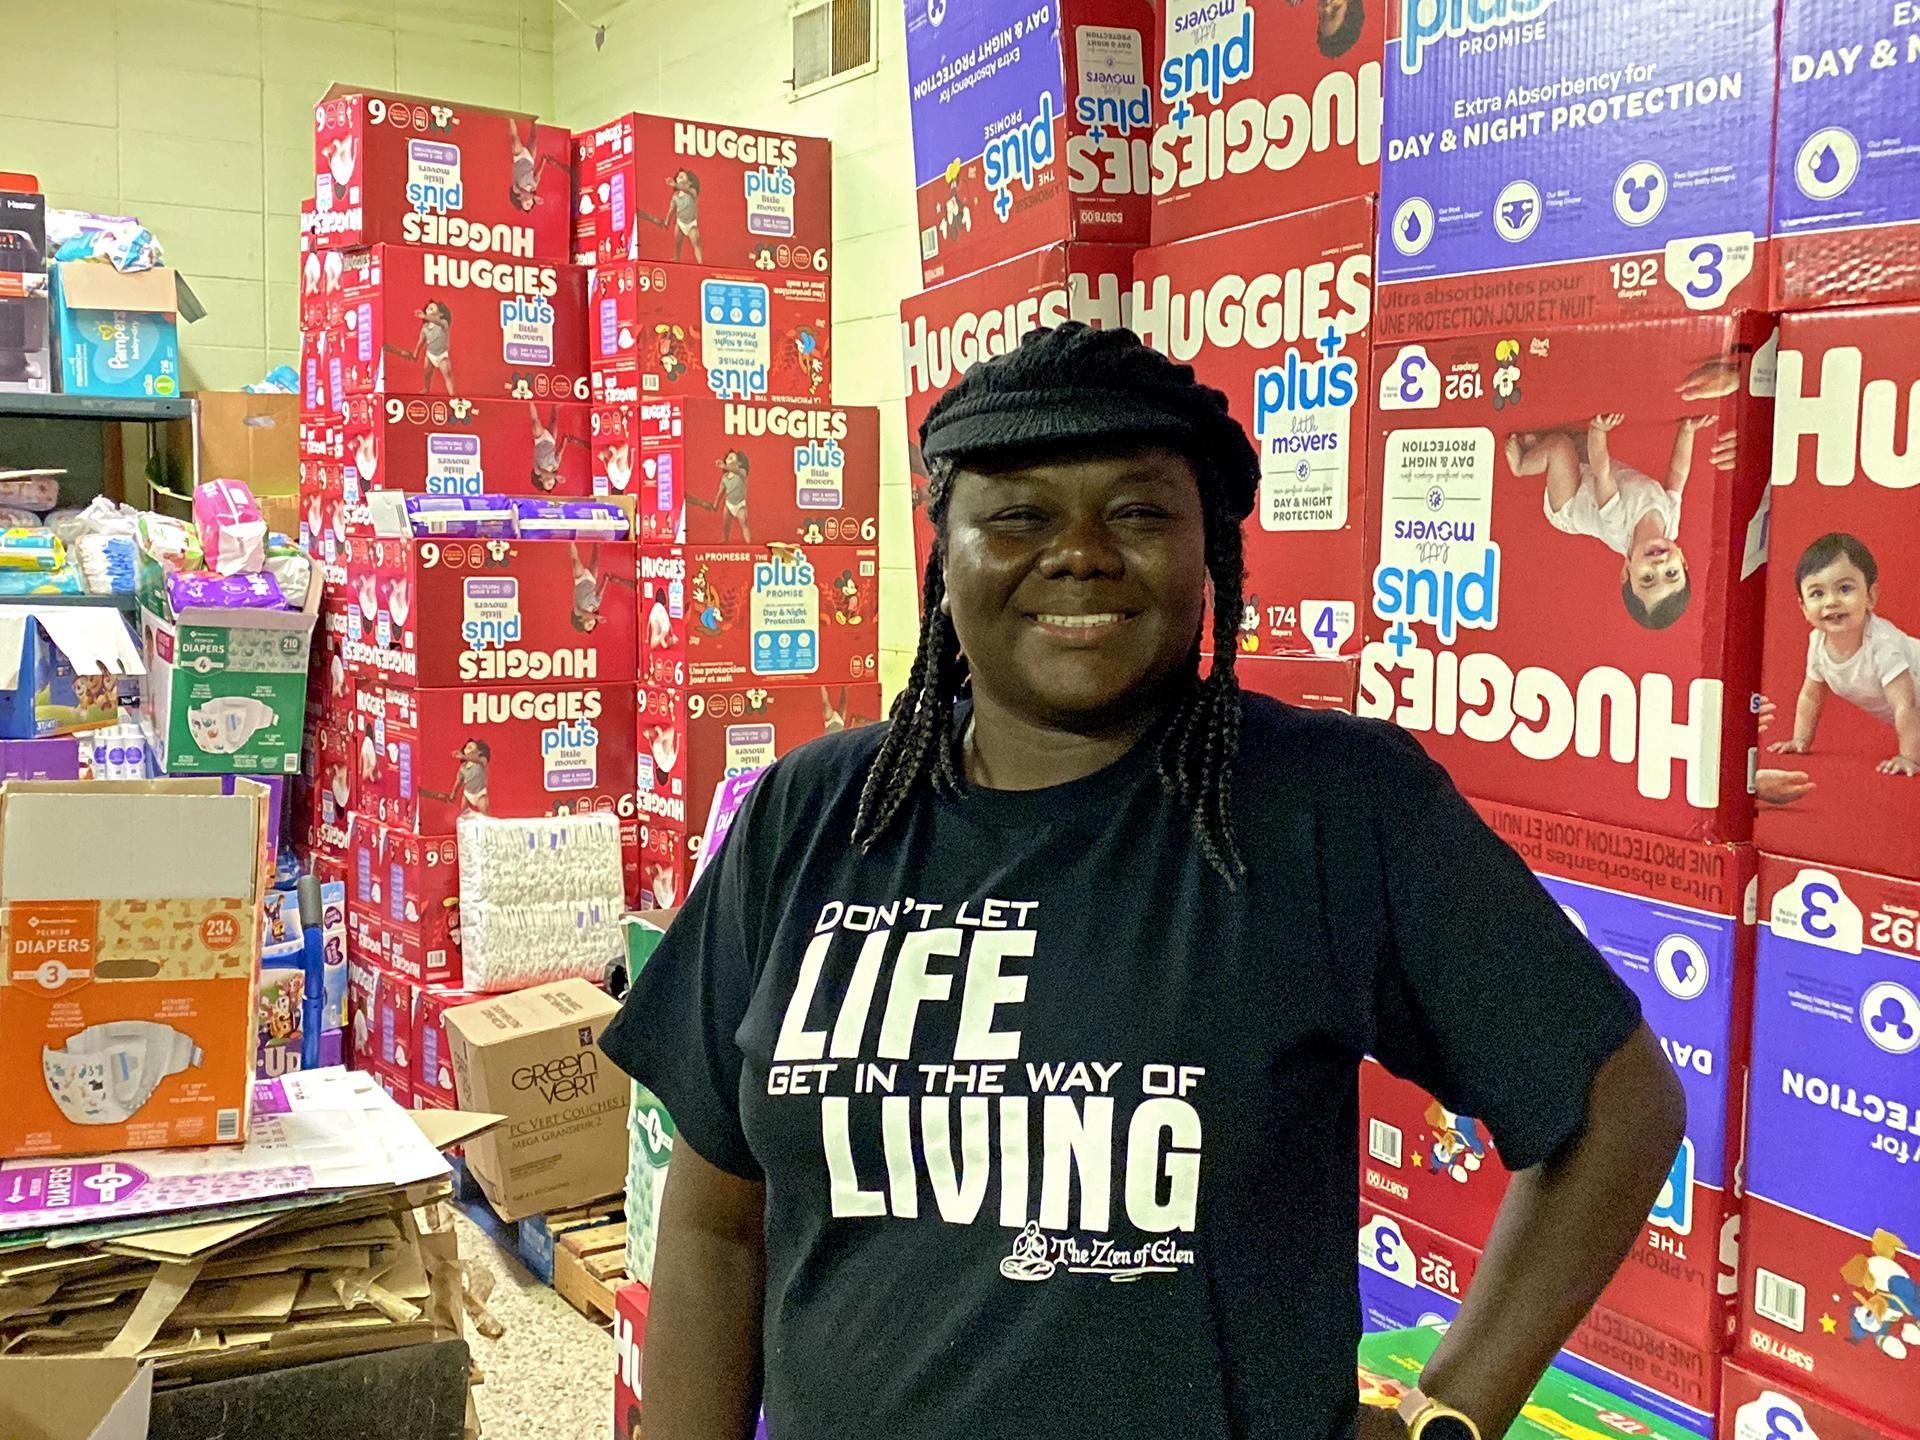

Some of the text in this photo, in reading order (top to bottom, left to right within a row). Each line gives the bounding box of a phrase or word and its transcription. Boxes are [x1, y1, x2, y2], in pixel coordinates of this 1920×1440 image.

[1174, 0, 1235, 33] movers
[1086, 31, 1132, 41] PROTECTION
[1087, 40, 1132, 50] DAY NIGHT
[1459, 21, 1546, 59] PROMISE
[914, 5, 1050, 101] DAY & NIGHT PROTECTION
[1163, 12, 1251, 100] plus
[1792, 45, 1862, 84] DAY
[1870, 39, 1898, 69] &
[938, 46, 1021, 104] Extra Absorbency for
[1086, 71, 1135, 85] movers
[1454, 62, 1657, 119] Extra Absorbency for
[367, 99, 386, 125] 6
[1079, 87, 1150, 133] plus
[1388, 72, 1743, 163] DAY & NIGHT PROTECTION
[984, 108, 1023, 140] PROMISE
[674, 123, 798, 169] HUGGIES
[985, 97, 1052, 187] plus
[417, 165, 451, 176] movers
[423, 174, 445, 185] little
[746, 169, 793, 197] plus
[1038, 169, 1055, 187] THE
[409, 182, 462, 213] plus
[756, 203, 786, 213] movers
[761, 195, 780, 205] little
[402, 212, 535, 258] HUGGIES
[812, 248, 828, 272] 6
[1686, 243, 1723, 298] 3
[424, 254, 558, 297] HUGGIES
[1610, 259, 1658, 289] 192
[1424, 275, 1585, 305] absorbantes pour
[1618, 289, 1648, 299] diapers
[503, 298, 552, 326] plus
[1133, 254, 1371, 362] HUGGIES
[1379, 295, 1597, 336] UNE PROTECTION JOUR ET NUIT
[512, 332, 544, 342] movers
[518, 324, 539, 333] little
[718, 357, 756, 367] PROMISE
[1451, 362, 1480, 372] diapers
[573, 376, 590, 400] 6
[710, 364, 766, 399] plus
[1400, 355, 1426, 403] 3
[1445, 373, 1484, 400] 192
[1258, 353, 1353, 435] plus
[384, 399, 404, 424] 6
[724, 404, 848, 441] HUGGIES
[796, 441, 843, 471] plus
[1272, 432, 1338, 455] movers
[1402, 440, 1477, 452] PROTECTION
[438, 457, 470, 468] movers
[443, 466, 465, 476] little
[811, 469, 830, 478] little
[1401, 456, 1475, 468] DAY & NIGHT
[428, 472, 482, 495] plus
[805, 477, 835, 487] movers
[1273, 496, 1333, 508] DAY & NIGHT
[1273, 509, 1333, 521] PROTECTION
[860, 517, 877, 541] 6
[1394, 520, 1476, 542] movers
[420, 543, 440, 568] 6
[641, 556, 686, 581] HUGGIES
[705, 552, 768, 563] PROMESSE THE
[756, 557, 812, 593] plus
[474, 601, 508, 611] movers
[766, 589, 804, 598] PROMISE
[1377, 548, 1495, 638] plus
[480, 609, 502, 619] little
[762, 607, 808, 618] Day Night
[764, 616, 806, 626] Protection
[1267, 605, 1297, 628] 174
[465, 615, 520, 648] plus
[1313, 606, 1338, 649] 4
[182, 643, 225, 654] DIAPERS
[283, 639, 298, 648] 210
[459, 648, 598, 681] HUGGIES
[674, 661, 684, 685] 6
[688, 664, 746, 676] Une protection
[865, 653, 875, 669] 6
[462, 690, 602, 724] HUGGIES
[688, 694, 705, 720] 6
[1359, 641, 1724, 808] HUGGIES
[544, 724, 597, 756] plus
[560, 748, 582, 759] little
[554, 758, 587, 768] movers
[617, 793, 634, 817] 6
[1525, 816, 1543, 840] ET
[1545, 818, 1584, 847] JOUR
[1585, 829, 1687, 872] PROTECTION
[1688, 848, 1725, 878] UNE
[1546, 848, 1724, 904] Ultra absorbantes
[956, 898, 1039, 928] LET
[1801, 882, 1839, 938] 3
[207, 920, 234, 936] 234
[15, 938, 91, 954] DIAPERS
[46, 965, 59, 983] 3
[773, 928, 1037, 1061] LIFE
[767, 1062, 1206, 1097] GET IN THE WAY OF
[1782, 1068, 1920, 1137] TECTION
[1871, 1133, 1909, 1164] for
[821, 1096, 1202, 1233] LIVING
[46, 1166, 72, 1208] DIAPERS
[1050, 1236, 1195, 1267] The Zen of Glen
[1375, 1226, 1401, 1273] 3
[1648, 1230, 1687, 1260] THE
[1421, 1257, 1460, 1294] 192
